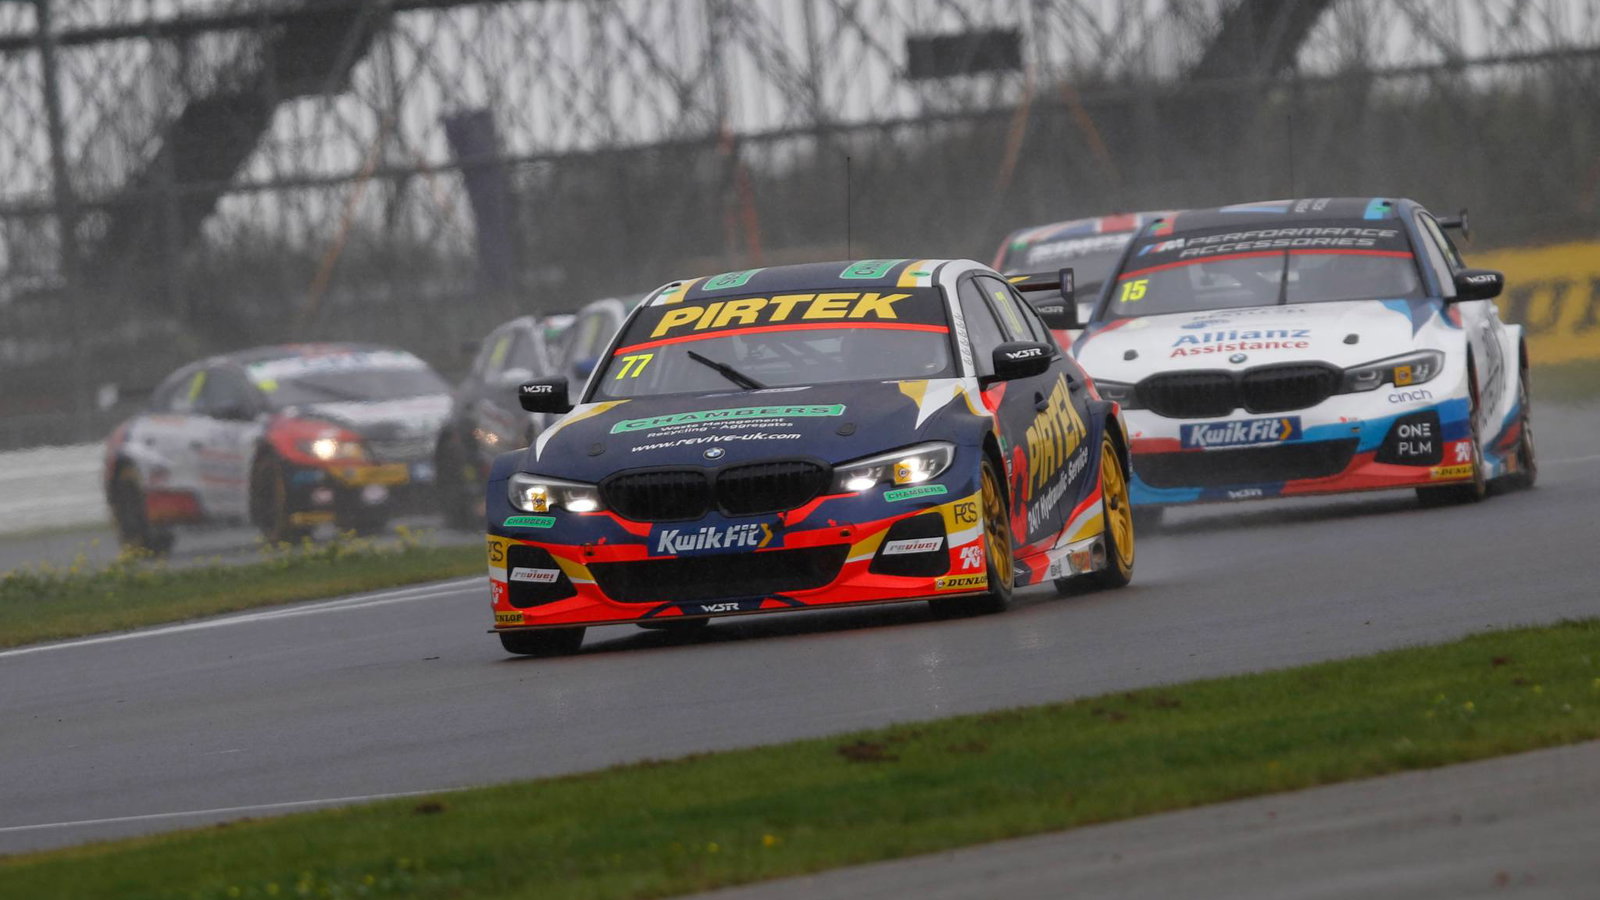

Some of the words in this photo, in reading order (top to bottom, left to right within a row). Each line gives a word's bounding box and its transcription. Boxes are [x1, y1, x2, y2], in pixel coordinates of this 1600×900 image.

[1185, 227, 1399, 248] PERFORMANCE
[1179, 237, 1375, 258] ACCESSORIES
[1121, 279, 1149, 302] 15
[650, 292, 912, 338] PIRTEK
[1171, 329, 1312, 347] Allianz
[1005, 348, 1043, 360] WSR
[1170, 340, 1310, 358] Assistance
[615, 353, 655, 380] 77
[523, 385, 553, 394] WSR
[1388, 389, 1433, 404] cinch
[625, 406, 830, 429] CHAMBERS
[660, 421, 704, 432] Waste
[708, 417, 785, 427] Management
[646, 427, 707, 438] Recycling
[721, 422, 793, 432] Aggregates
[1026, 372, 1087, 502] PIRTEK
[1397, 422, 1432, 438] ONE
[631, 432, 801, 453] www.revive-uk.com
[1398, 441, 1433, 456] PLM
[888, 486, 944, 500] CHAMBERS
[1027, 500, 1041, 535] 24/7
[1068, 445, 1089, 486] Service
[507, 517, 553, 526] CHAMBERS
[700, 602, 740, 612] WSR
